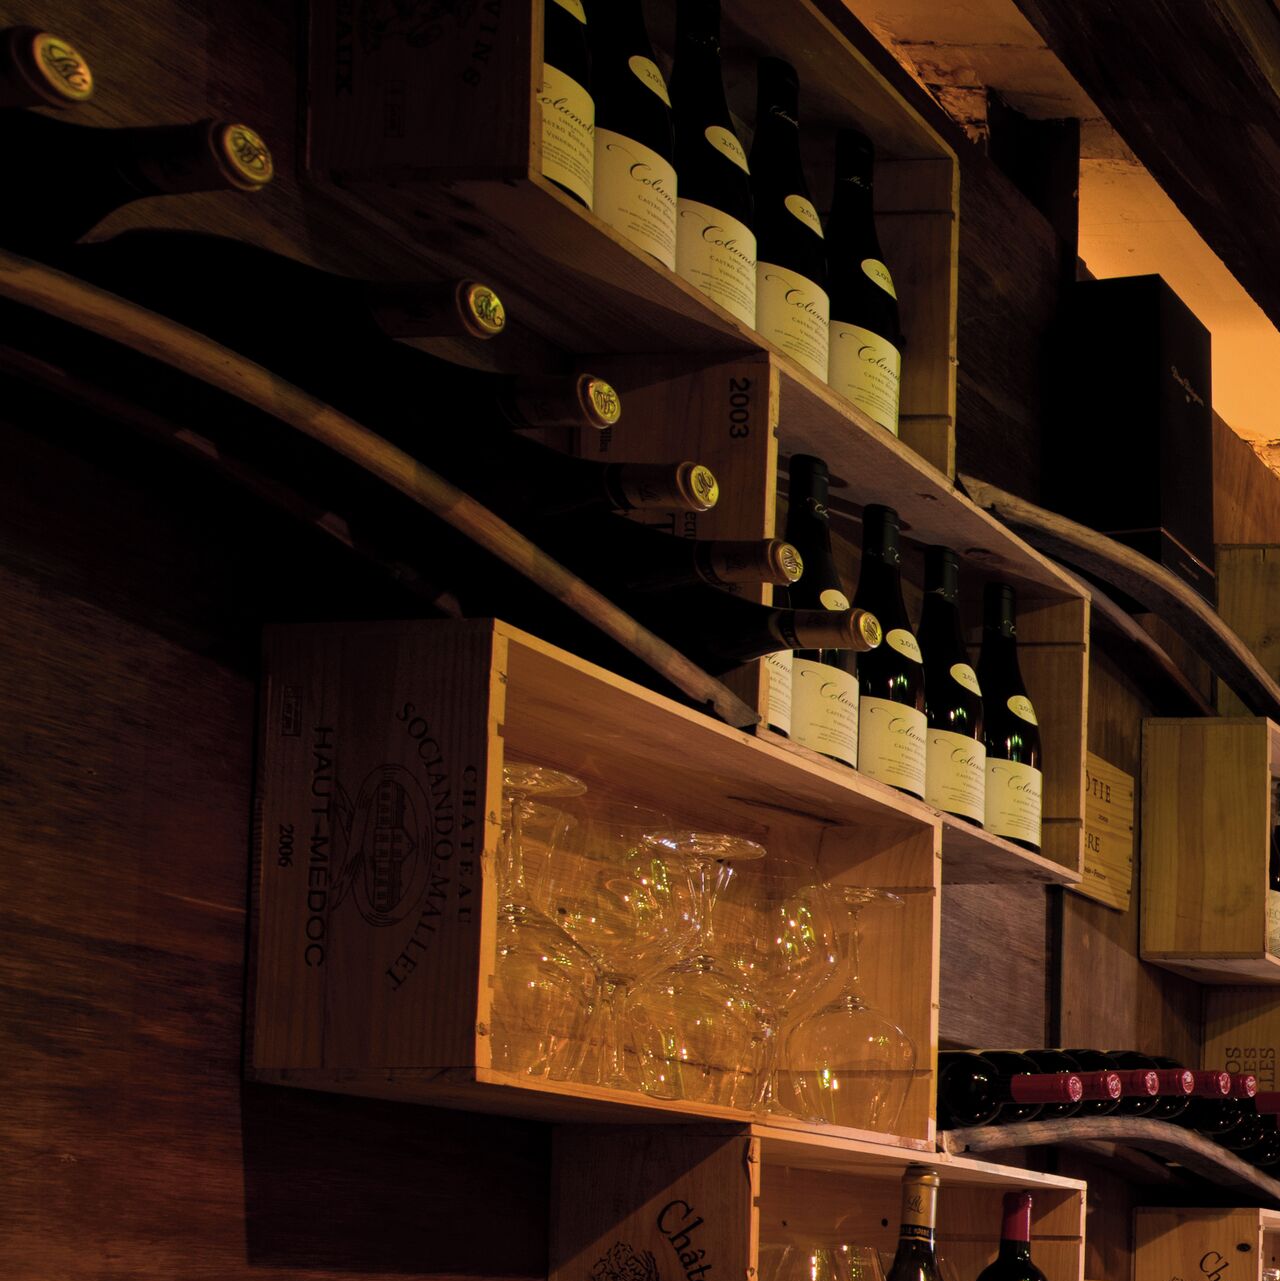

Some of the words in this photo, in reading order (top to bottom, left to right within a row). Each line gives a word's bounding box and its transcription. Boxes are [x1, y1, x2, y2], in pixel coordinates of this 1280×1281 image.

[729, 377, 750, 439] 2003
[277, 823, 294, 868] 2006
[304, 726, 334, 967] HAUT-MEDOC
[386, 702, 455, 991] SOCIANDO-MALLET
[458, 765, 477, 924] CHATEAU
